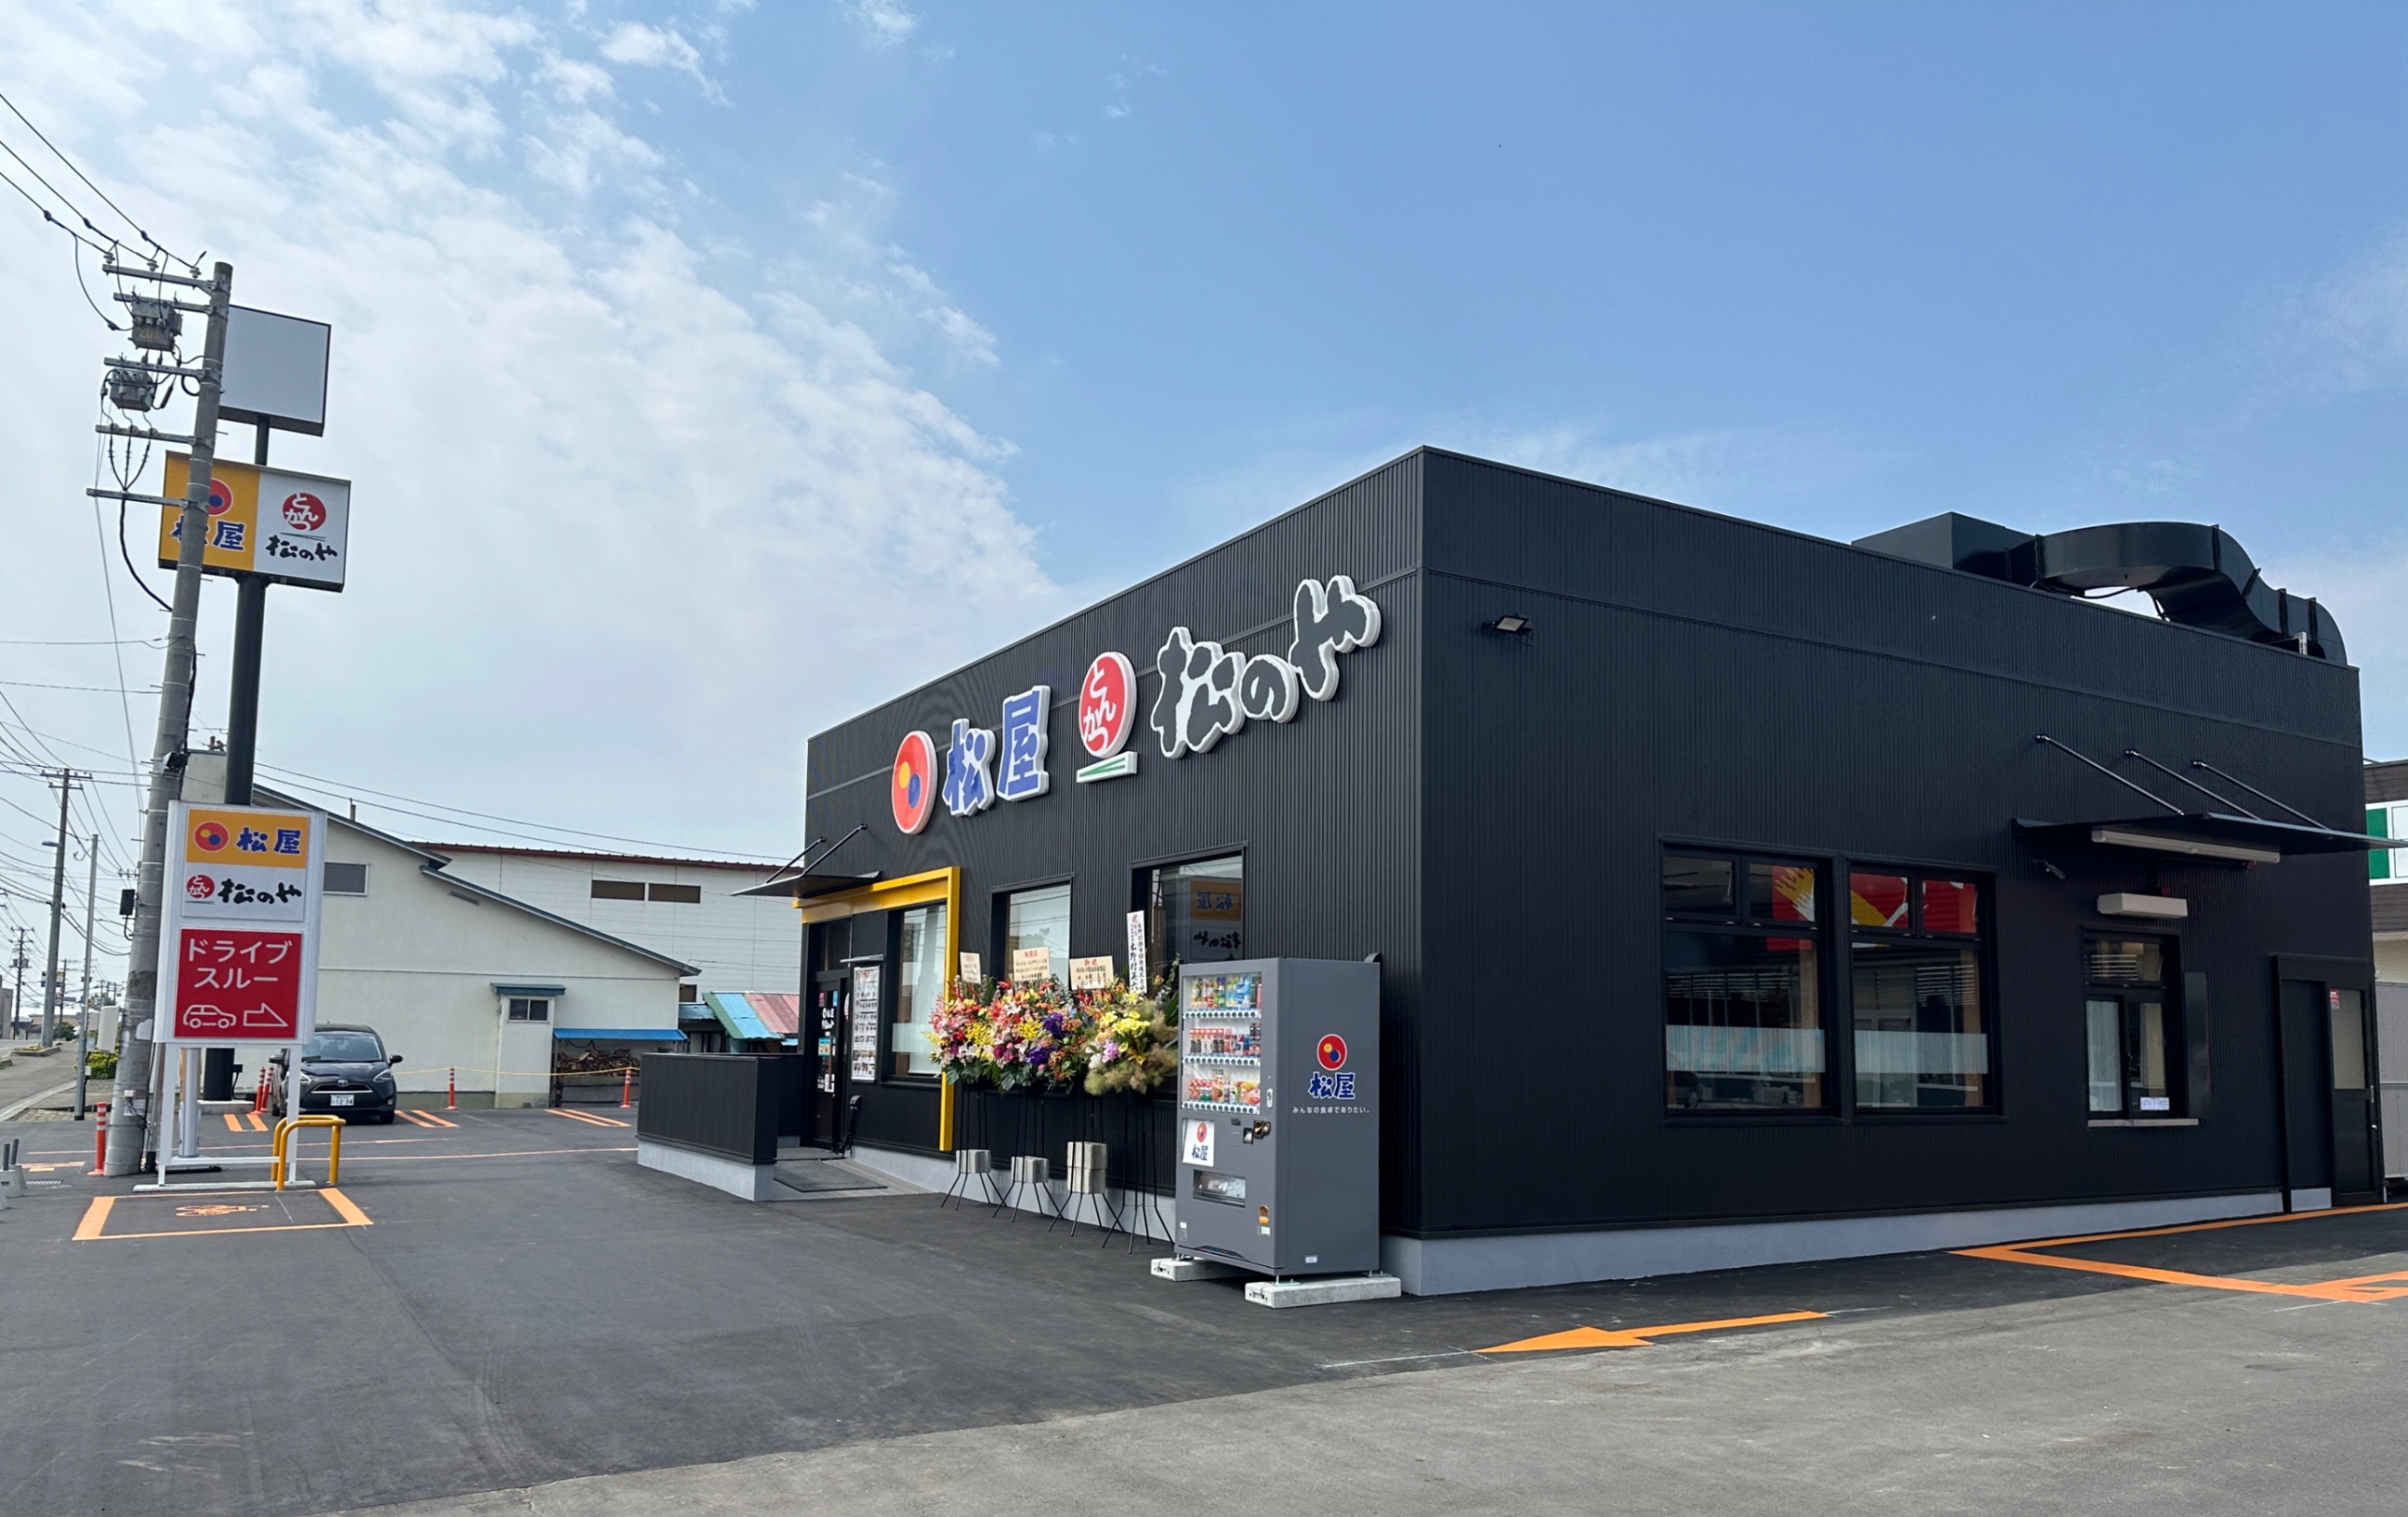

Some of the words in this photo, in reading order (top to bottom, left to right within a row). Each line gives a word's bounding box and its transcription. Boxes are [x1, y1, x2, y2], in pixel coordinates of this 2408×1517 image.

[284, 493, 320, 531] とんかつ
[266, 535, 338, 562] 松のや
[1151, 575, 1381, 758] 松のや
[1083, 660, 1117, 752] とんかつ
[942, 685, 1051, 816] 松屋
[236, 826, 301, 854] 松屋
[217, 877, 302, 904] 松のや
[188, 938, 293, 964] ドライブ
[194, 967, 278, 989] スルー
[1307, 1071, 1356, 1100] 松屋
[1192, 1144, 1209, 1162] 松屋
